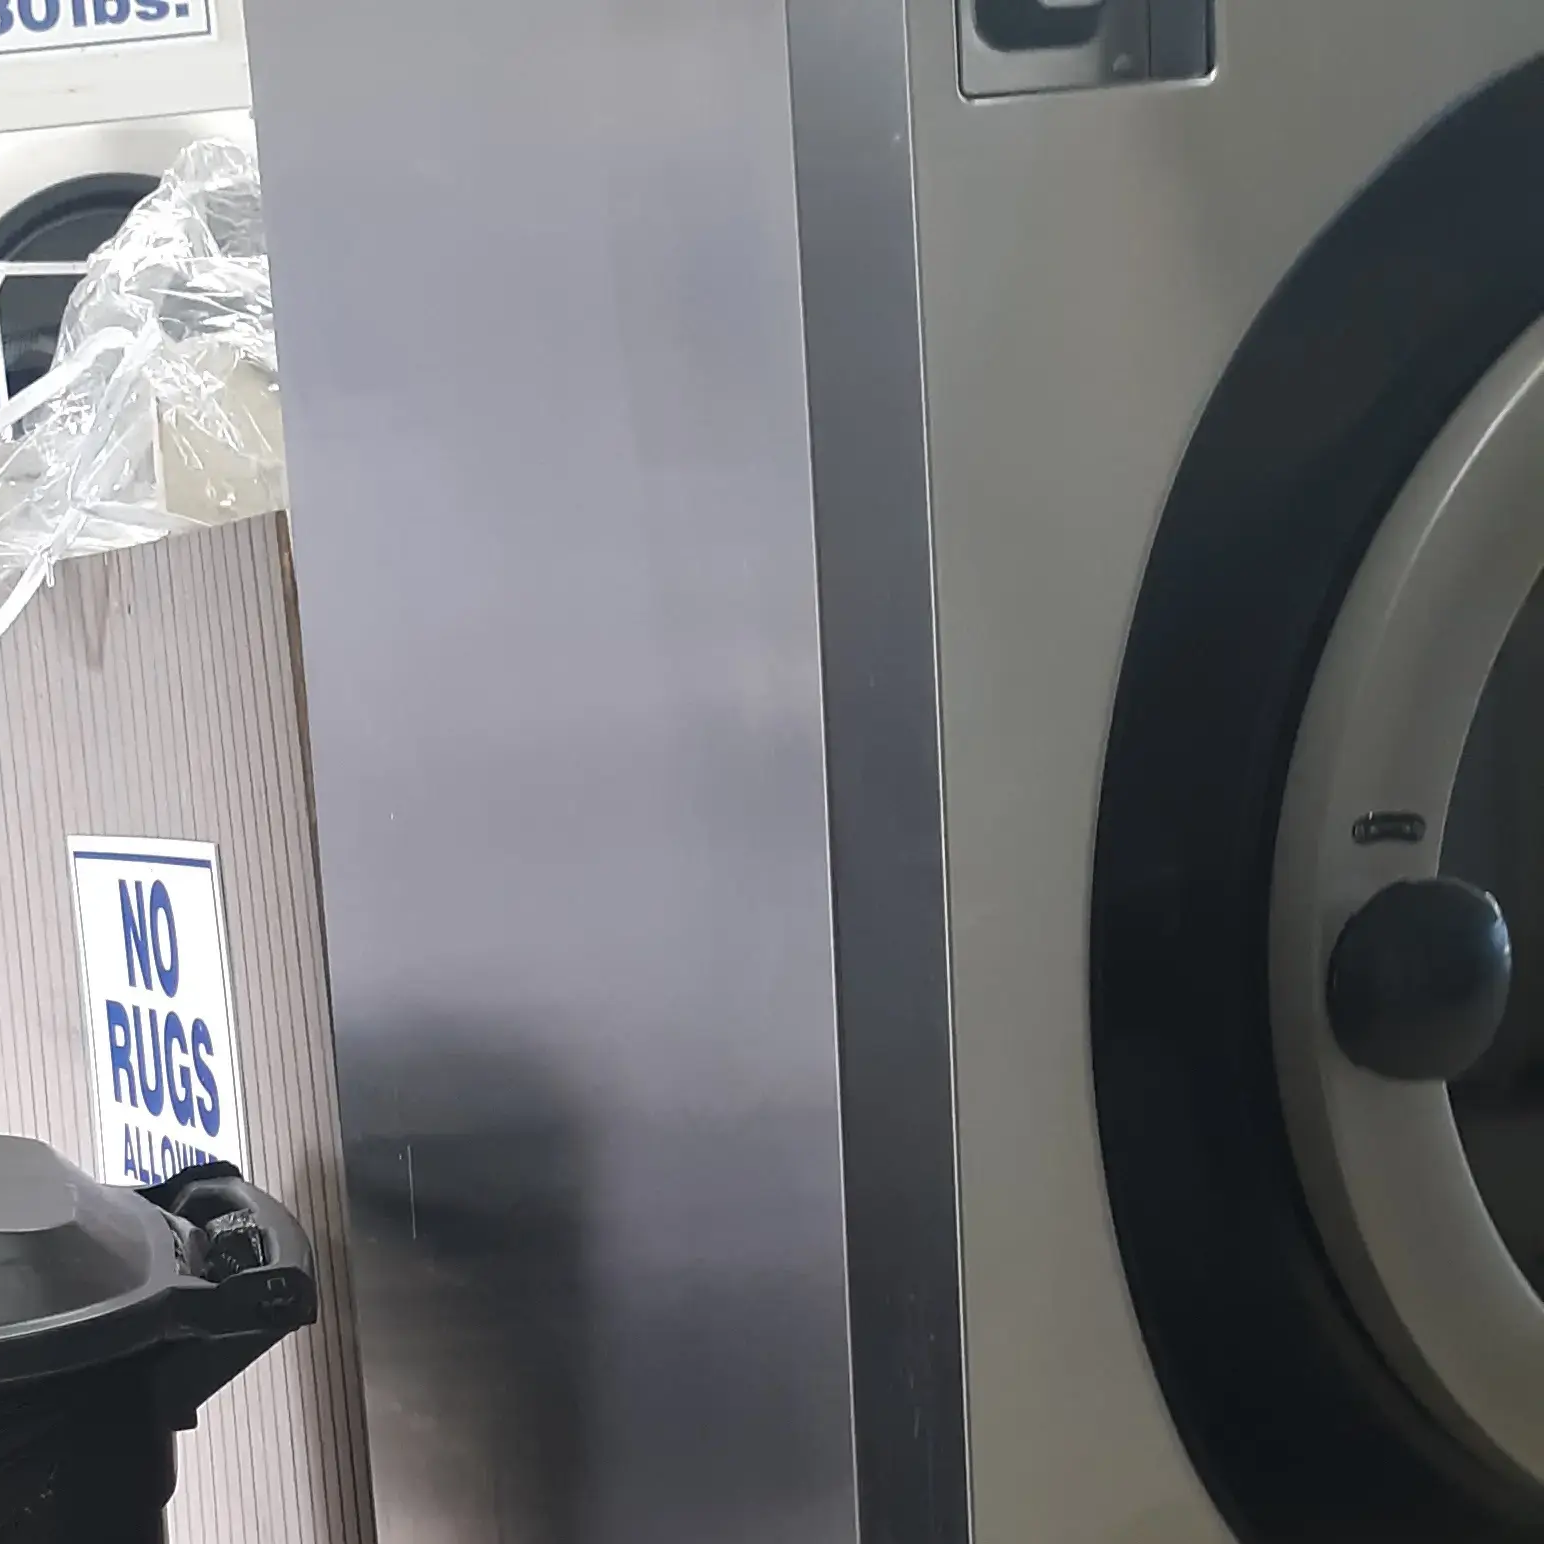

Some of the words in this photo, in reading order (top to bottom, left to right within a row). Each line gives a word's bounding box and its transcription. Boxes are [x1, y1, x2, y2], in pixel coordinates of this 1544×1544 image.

[119, 879, 179, 998] NO
[106, 999, 220, 1137] RUGS
[124, 1123, 219, 1186] ALLOW
